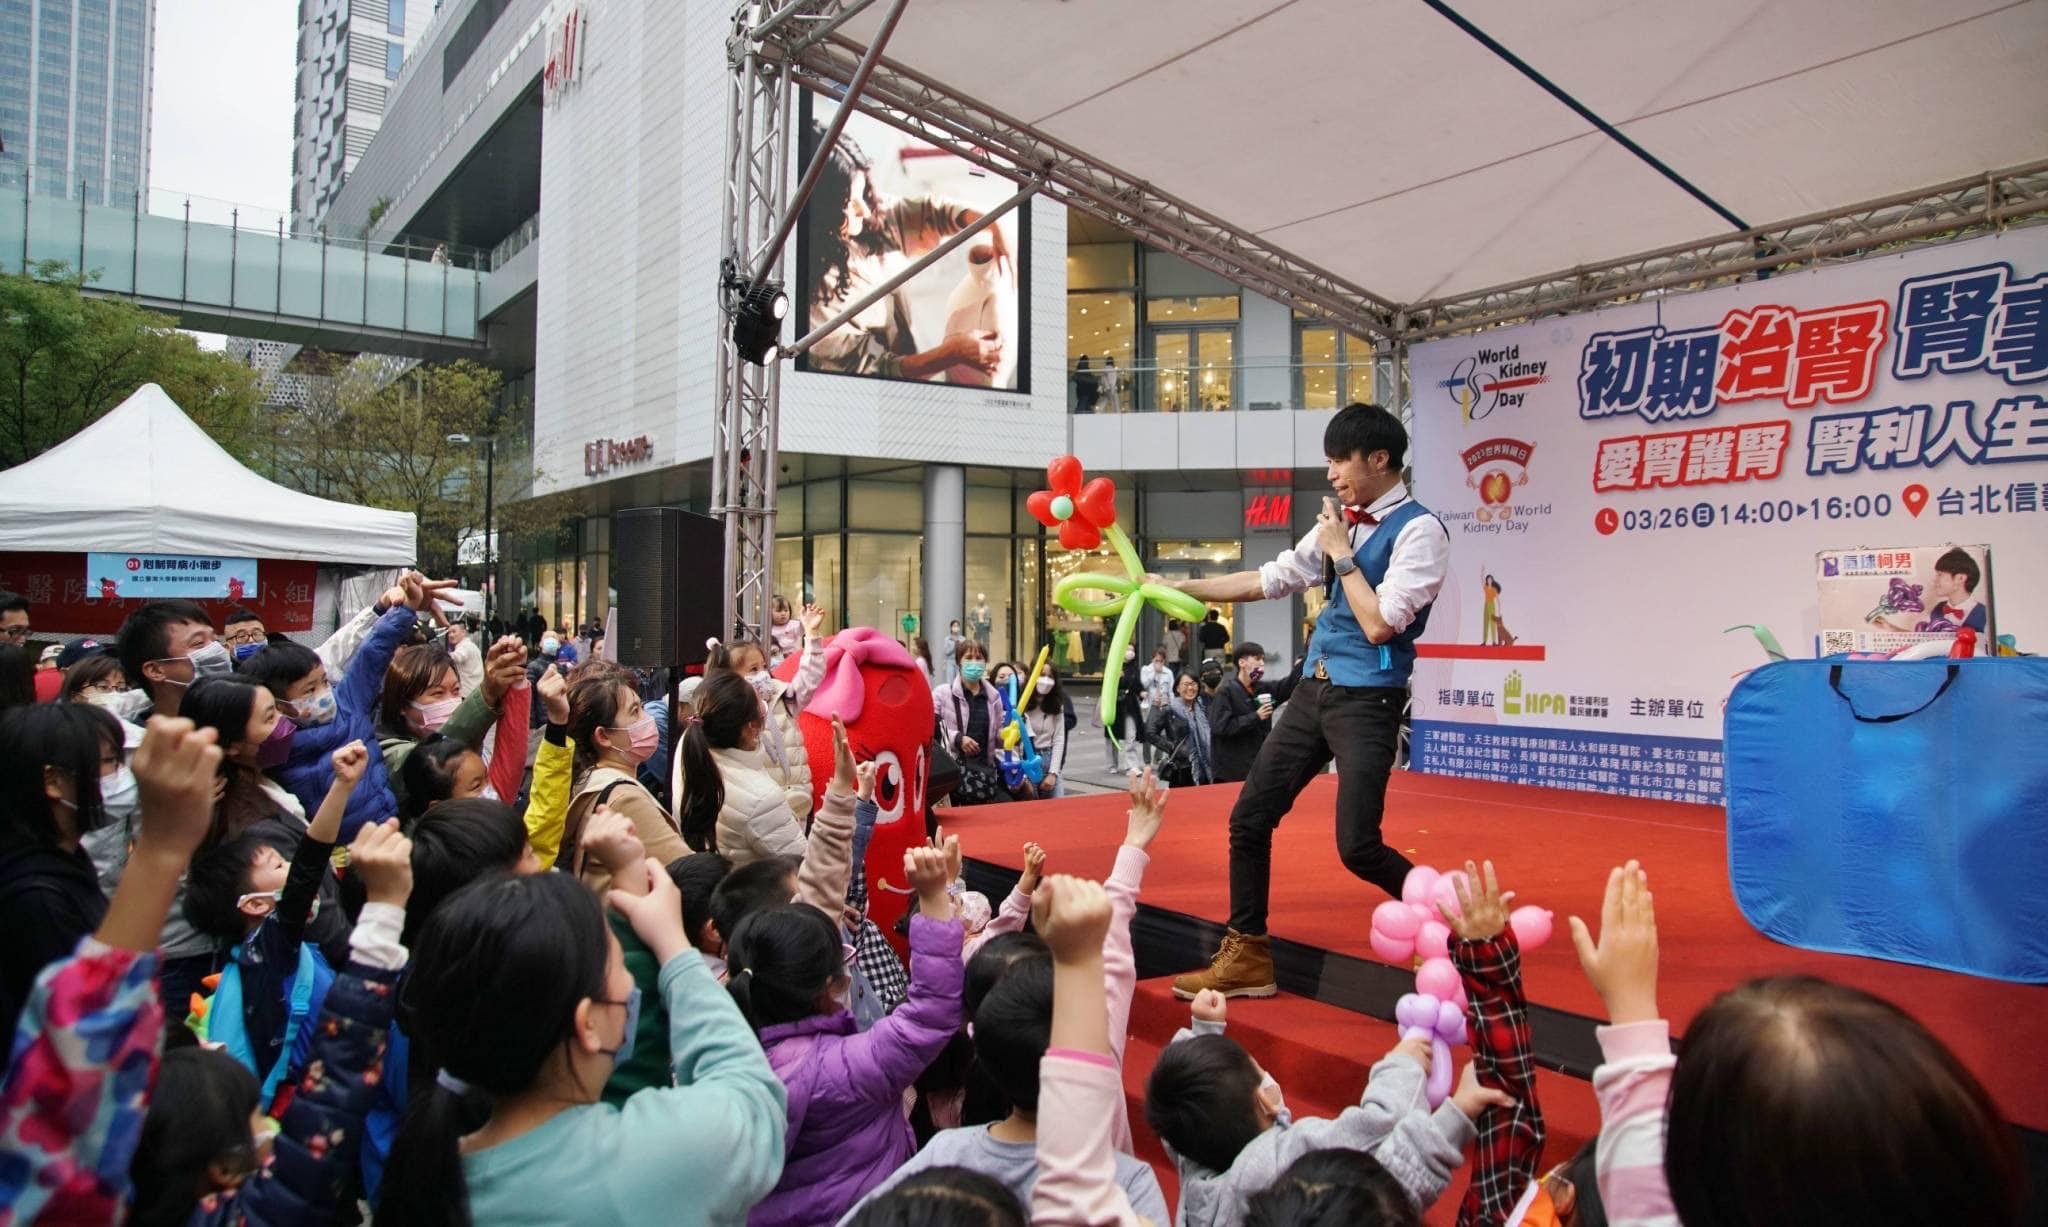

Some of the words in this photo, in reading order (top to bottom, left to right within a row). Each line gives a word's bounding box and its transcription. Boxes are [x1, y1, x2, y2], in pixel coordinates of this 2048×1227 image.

[1478, 344, 1519, 364] World
[1580, 301, 1888, 420] 初期治腎
[1499, 360, 1547, 379] Kidney
[1500, 392, 1525, 408] Day
[1594, 420, 1790, 491] 愛腎護腎
[1808, 396, 2048, 475] 腎利人生
[1437, 510, 1475, 521] Taiwan
[1513, 503, 1552, 516] World
[1623, 508, 1689, 531] 03/26
[1720, 500, 1794, 525] 14:00
[1810, 494, 1892, 520] 16:00
[1936, 483, 2048, 516] 台北信
[1463, 521, 1502, 534] Kidney
[1506, 519, 1529, 532] Day
[1438, 688, 1495, 708] 指導單位
[1525, 693, 1566, 715] HPA
[1630, 697, 1705, 719] 主辦單位
